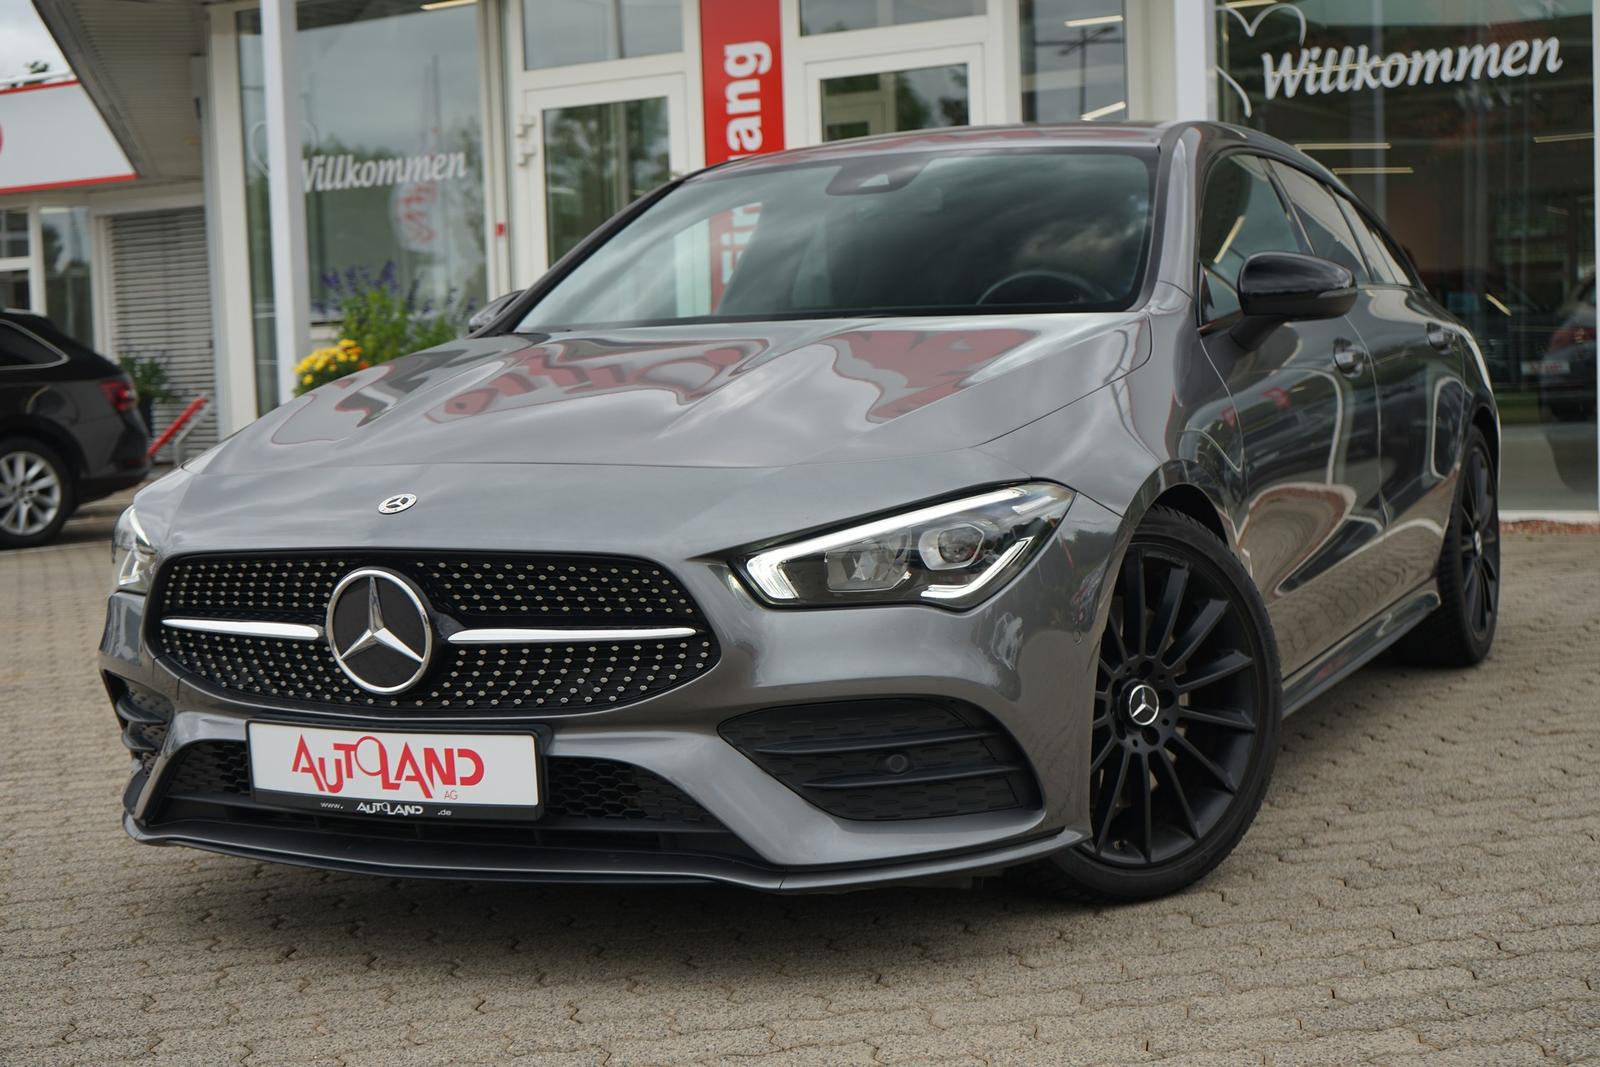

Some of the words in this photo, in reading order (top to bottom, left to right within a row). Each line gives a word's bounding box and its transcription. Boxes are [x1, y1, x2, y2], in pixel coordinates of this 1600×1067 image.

[1261, 36, 1563, 100] Willkommen
[443, 790, 458, 801] AG
[356, 802, 423, 817] AUTOLAND
